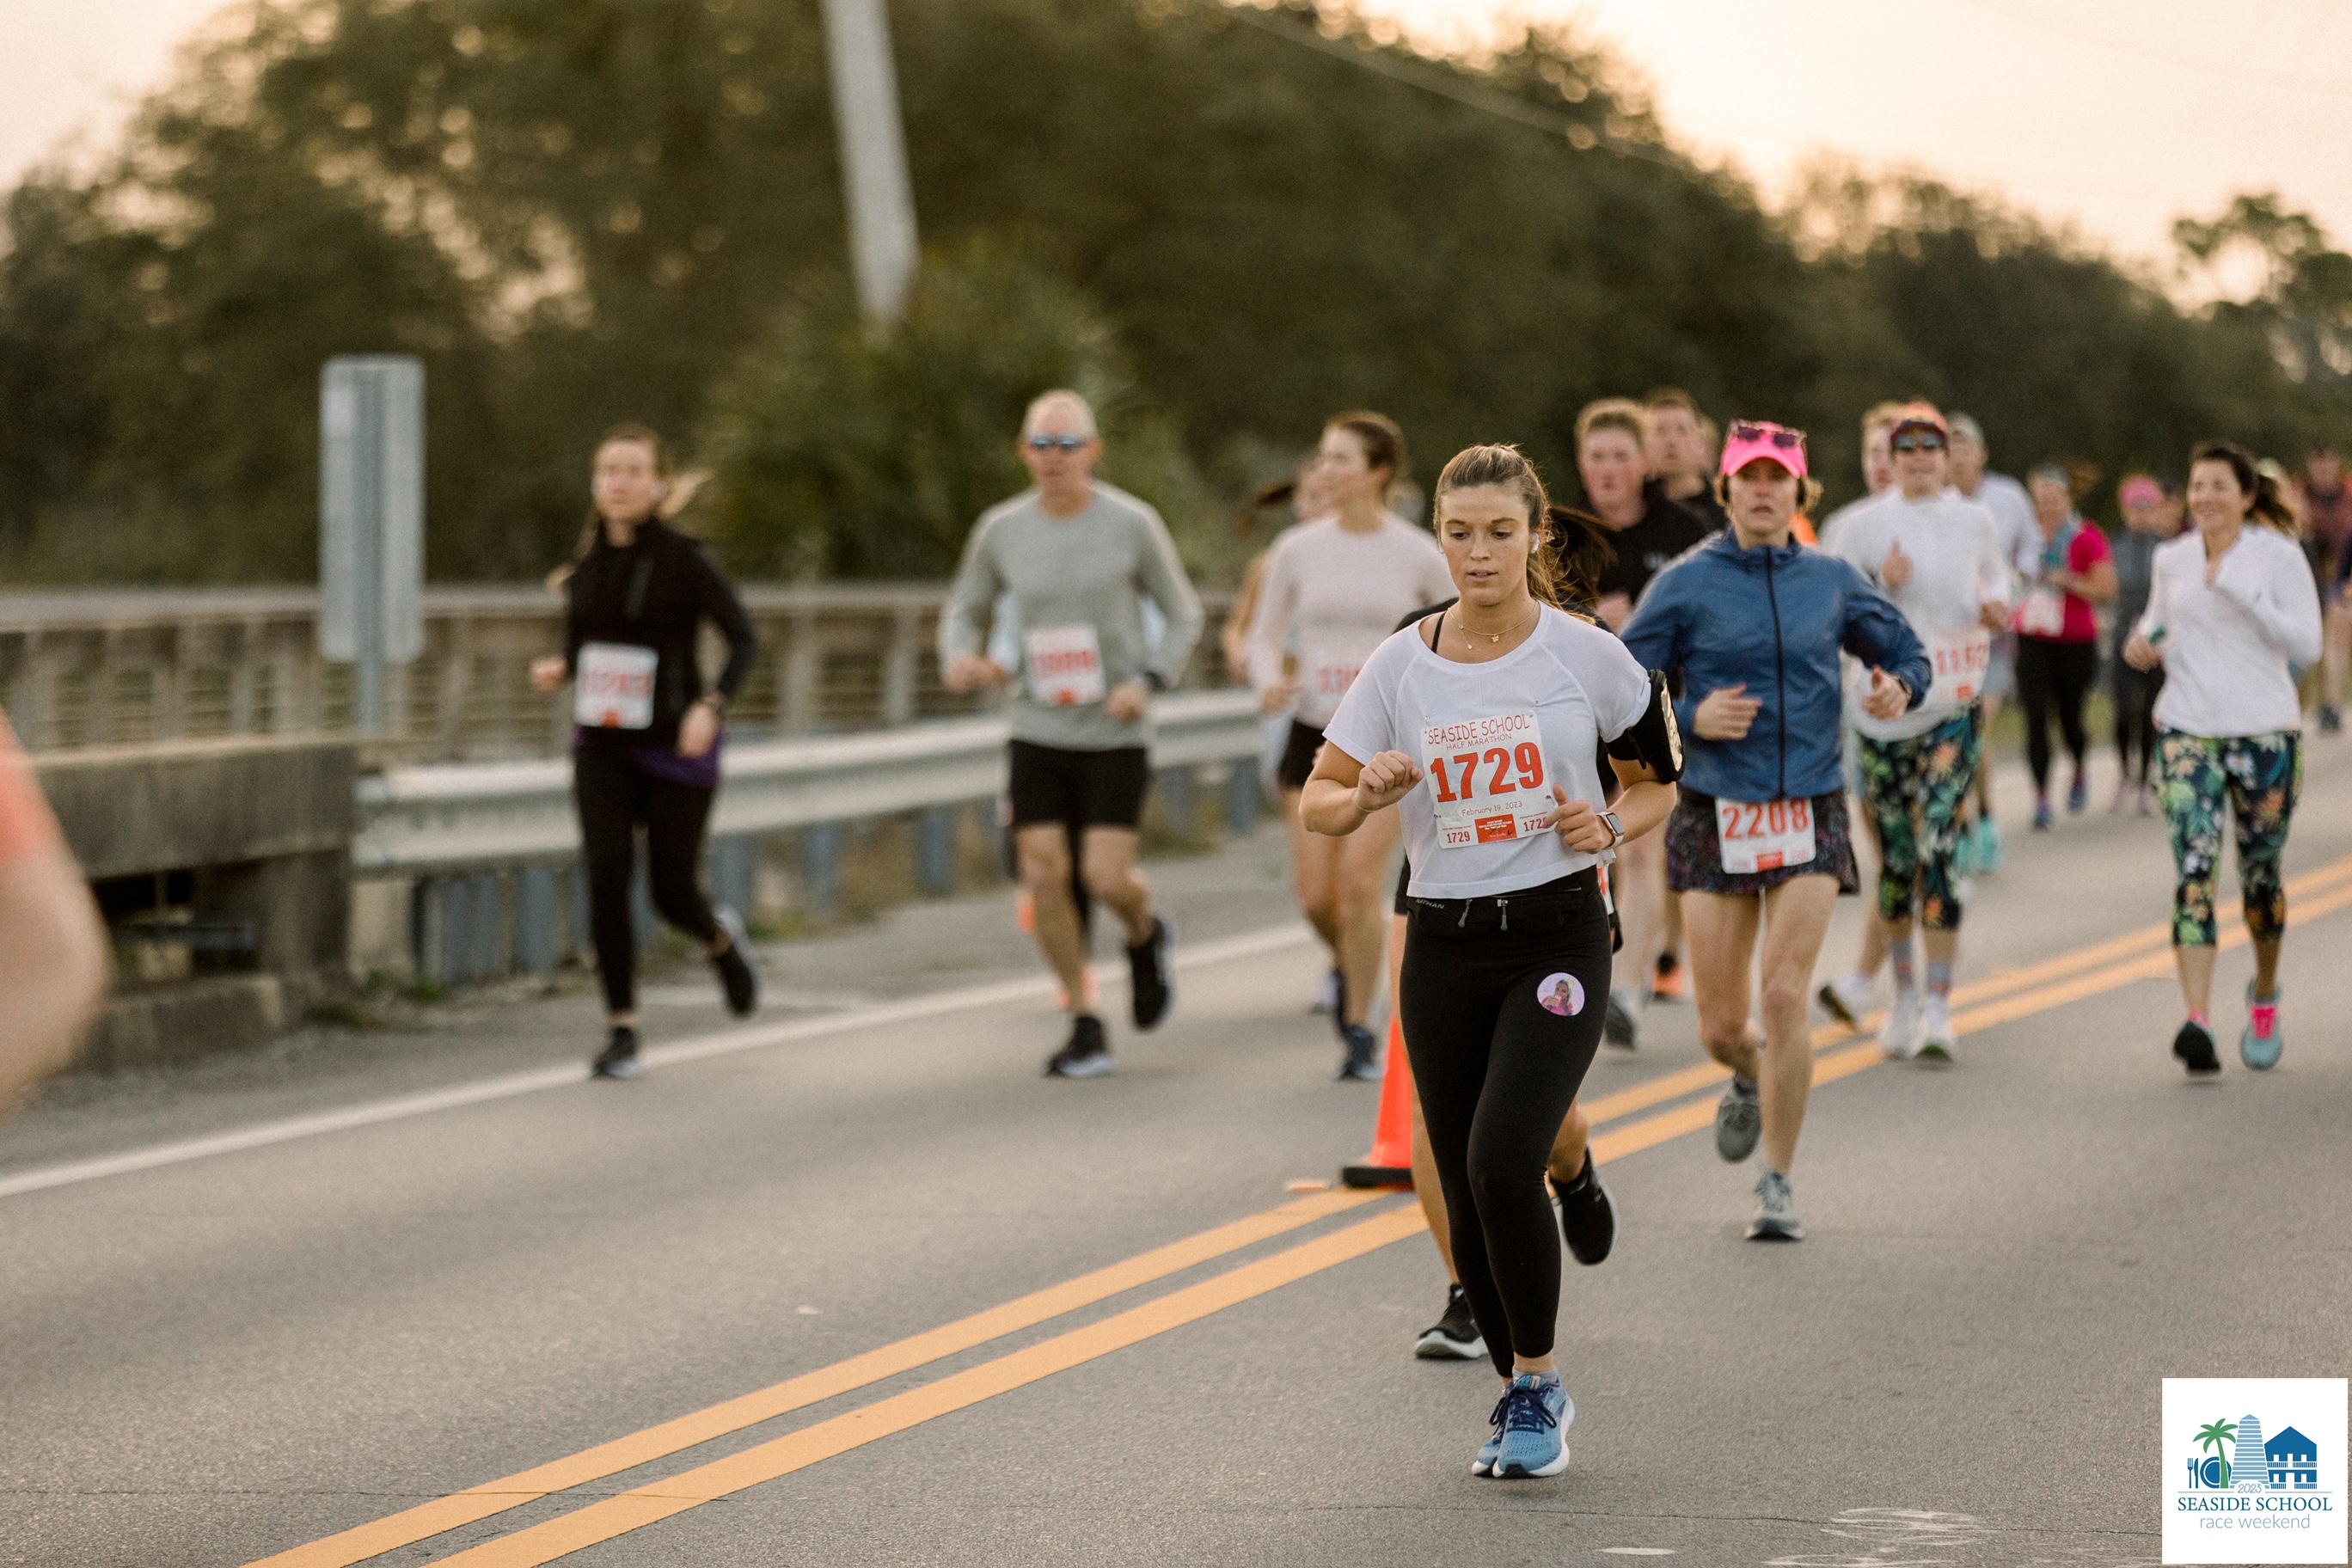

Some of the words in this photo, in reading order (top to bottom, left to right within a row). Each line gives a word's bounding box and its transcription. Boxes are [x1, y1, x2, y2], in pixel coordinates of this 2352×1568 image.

[1428, 721, 1477, 745] SEASIDE
[1481, 714, 1530, 736] SCHOOL
[1446, 741, 1466, 751] HALF
[1467, 733, 1512, 747] MARATHON
[1430, 742, 1544, 803] 1729
[1461, 805, 1492, 817] February
[1505, 801, 1522, 810] 2023
[1723, 798, 1810, 841] 2208
[1447, 830, 1471, 843] 1729
